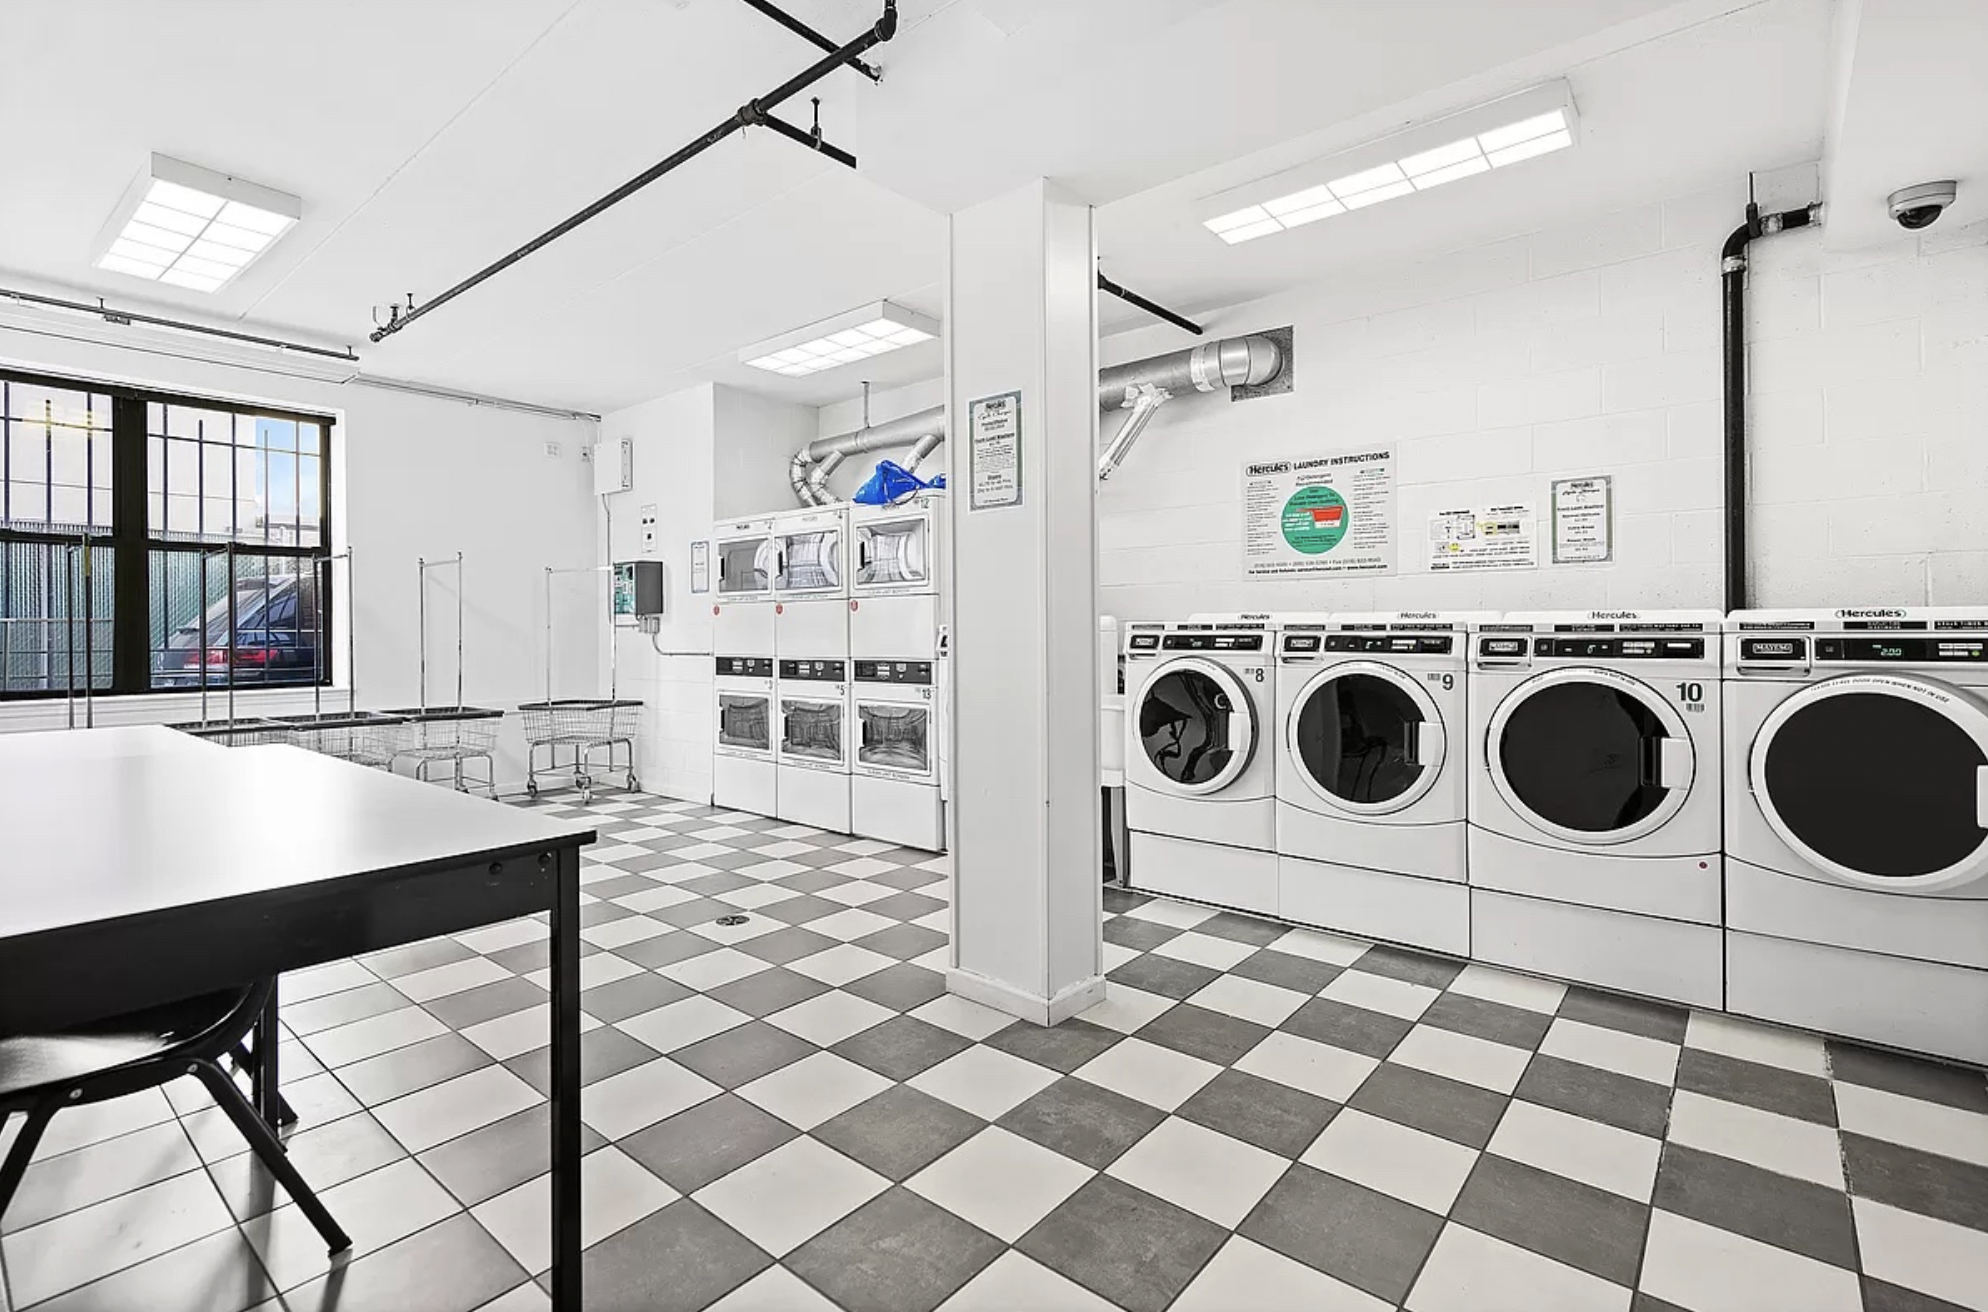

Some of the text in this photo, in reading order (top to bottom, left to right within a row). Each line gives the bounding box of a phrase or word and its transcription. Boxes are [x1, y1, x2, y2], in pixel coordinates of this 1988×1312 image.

[1249, 451, 1390, 475] Hercules LAUNDRY INSTRUCTIONS
[1591, 611, 1637, 619] Hercules
[1840, 609, 1902, 618] Hercules
[1255, 668, 1265, 682] 8
[1442, 673, 1454, 690] 9
[1676, 682, 1703, 702] 10
[1891, 680, 1911, 689] WHEN
[1912, 685, 1926, 694] NOT
[1935, 693, 1950, 703] USE
